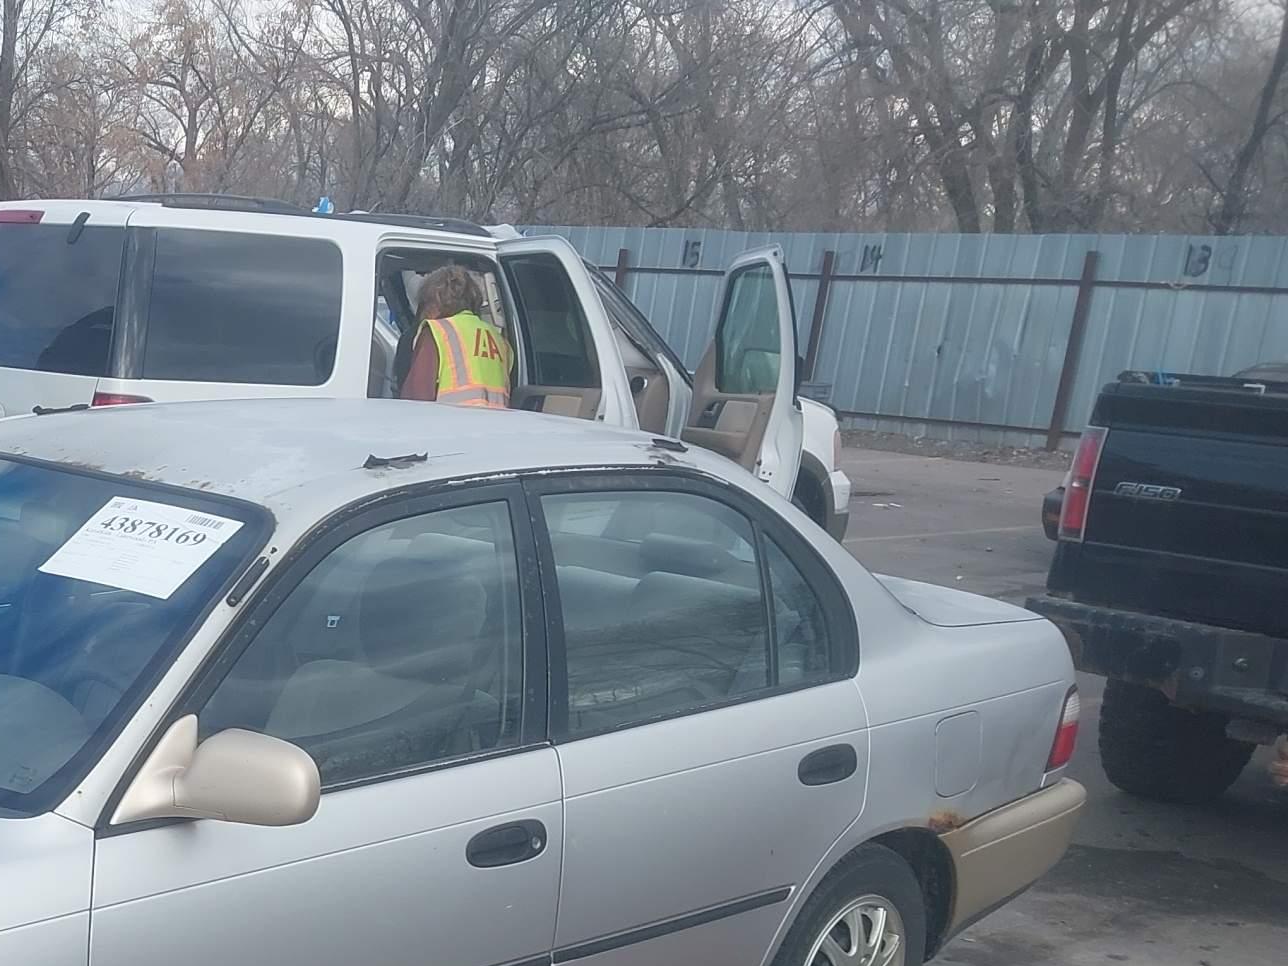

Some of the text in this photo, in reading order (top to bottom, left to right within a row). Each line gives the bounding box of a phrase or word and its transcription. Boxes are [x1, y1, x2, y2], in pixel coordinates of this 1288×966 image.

[682, 240, 702, 268] 15
[859, 244, 882, 273] 14
[1184, 244, 1211, 277] 13
[100, 515, 207, 547] 43878169
